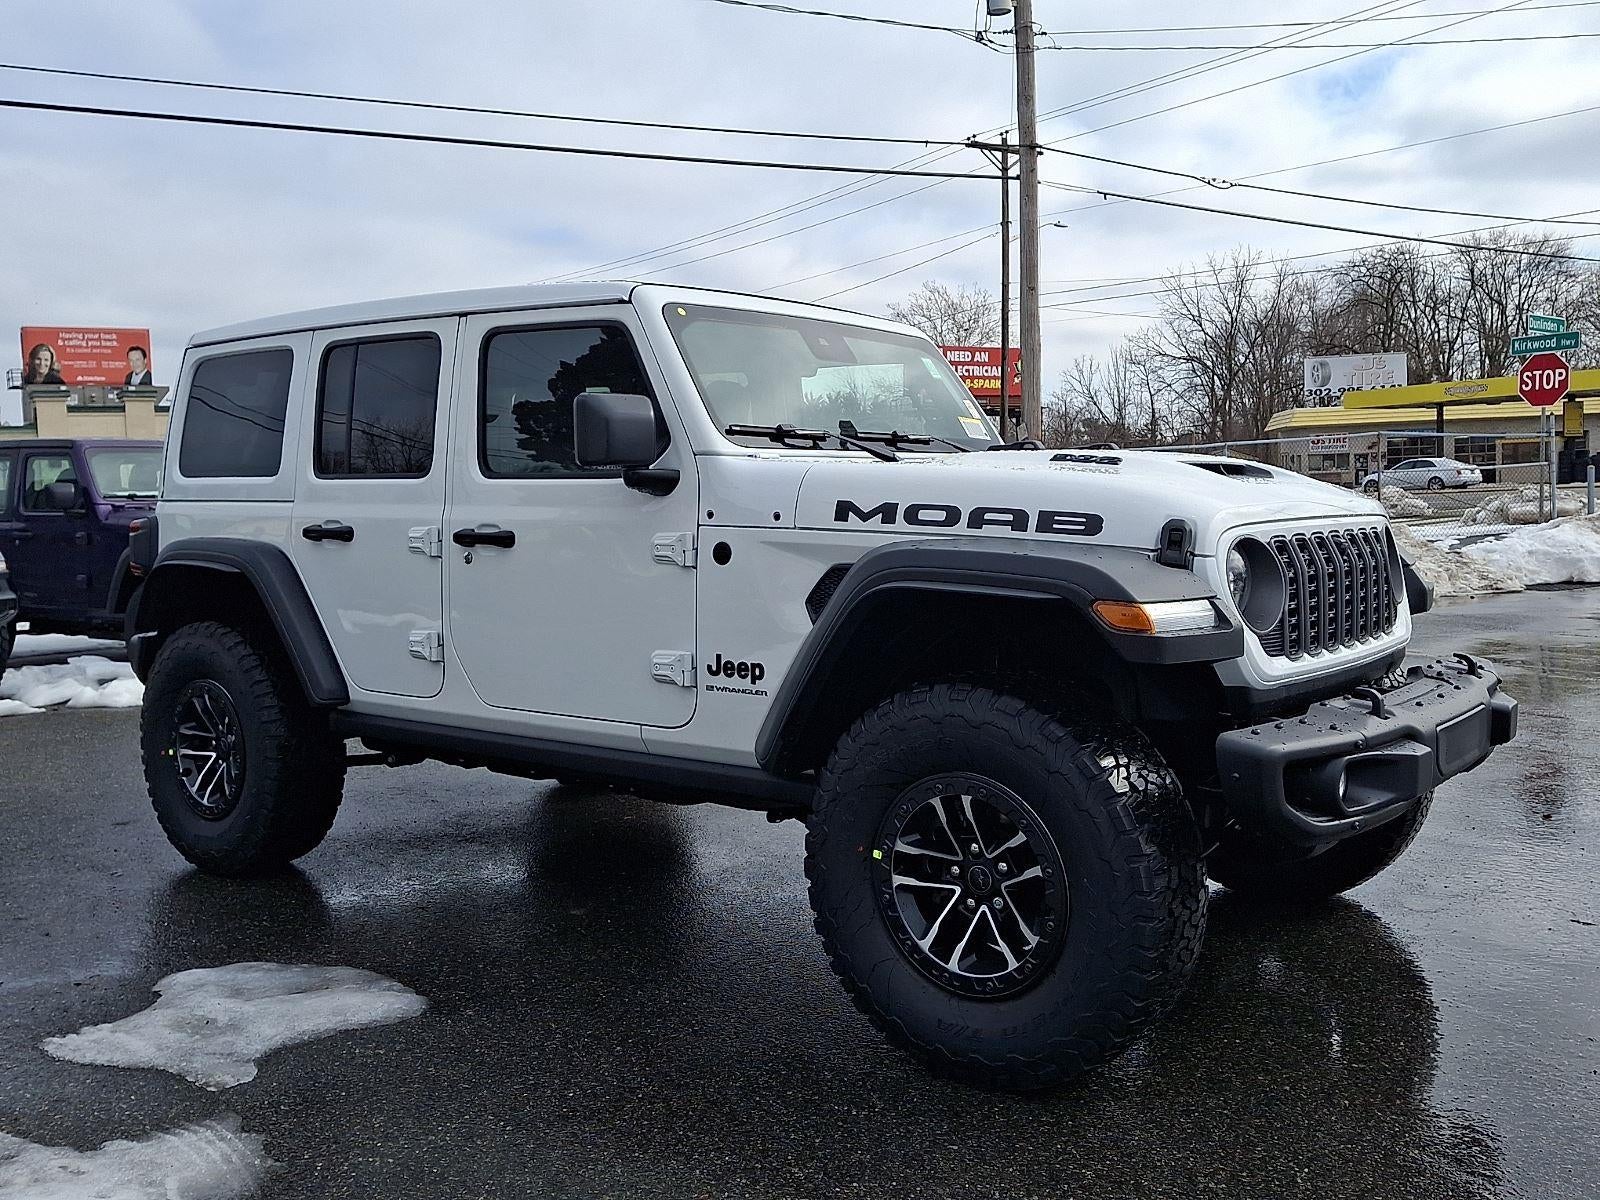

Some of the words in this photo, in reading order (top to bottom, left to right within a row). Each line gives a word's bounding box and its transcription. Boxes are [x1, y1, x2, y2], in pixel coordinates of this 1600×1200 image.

[1530, 318, 1557, 331] Dunlinden
[1514, 337, 1557, 351] Kirkwood
[1561, 338, 1576, 346] Hwy
[947, 350, 972, 361] NEED
[974, 351, 989, 362] AN
[1343, 370, 1395, 387] TIRE
[1521, 368, 1567, 391] STOP
[833, 499, 1105, 537] MOAB
[706, 653, 766, 686] Jeep
[714, 685, 769, 697] WRANGLER
